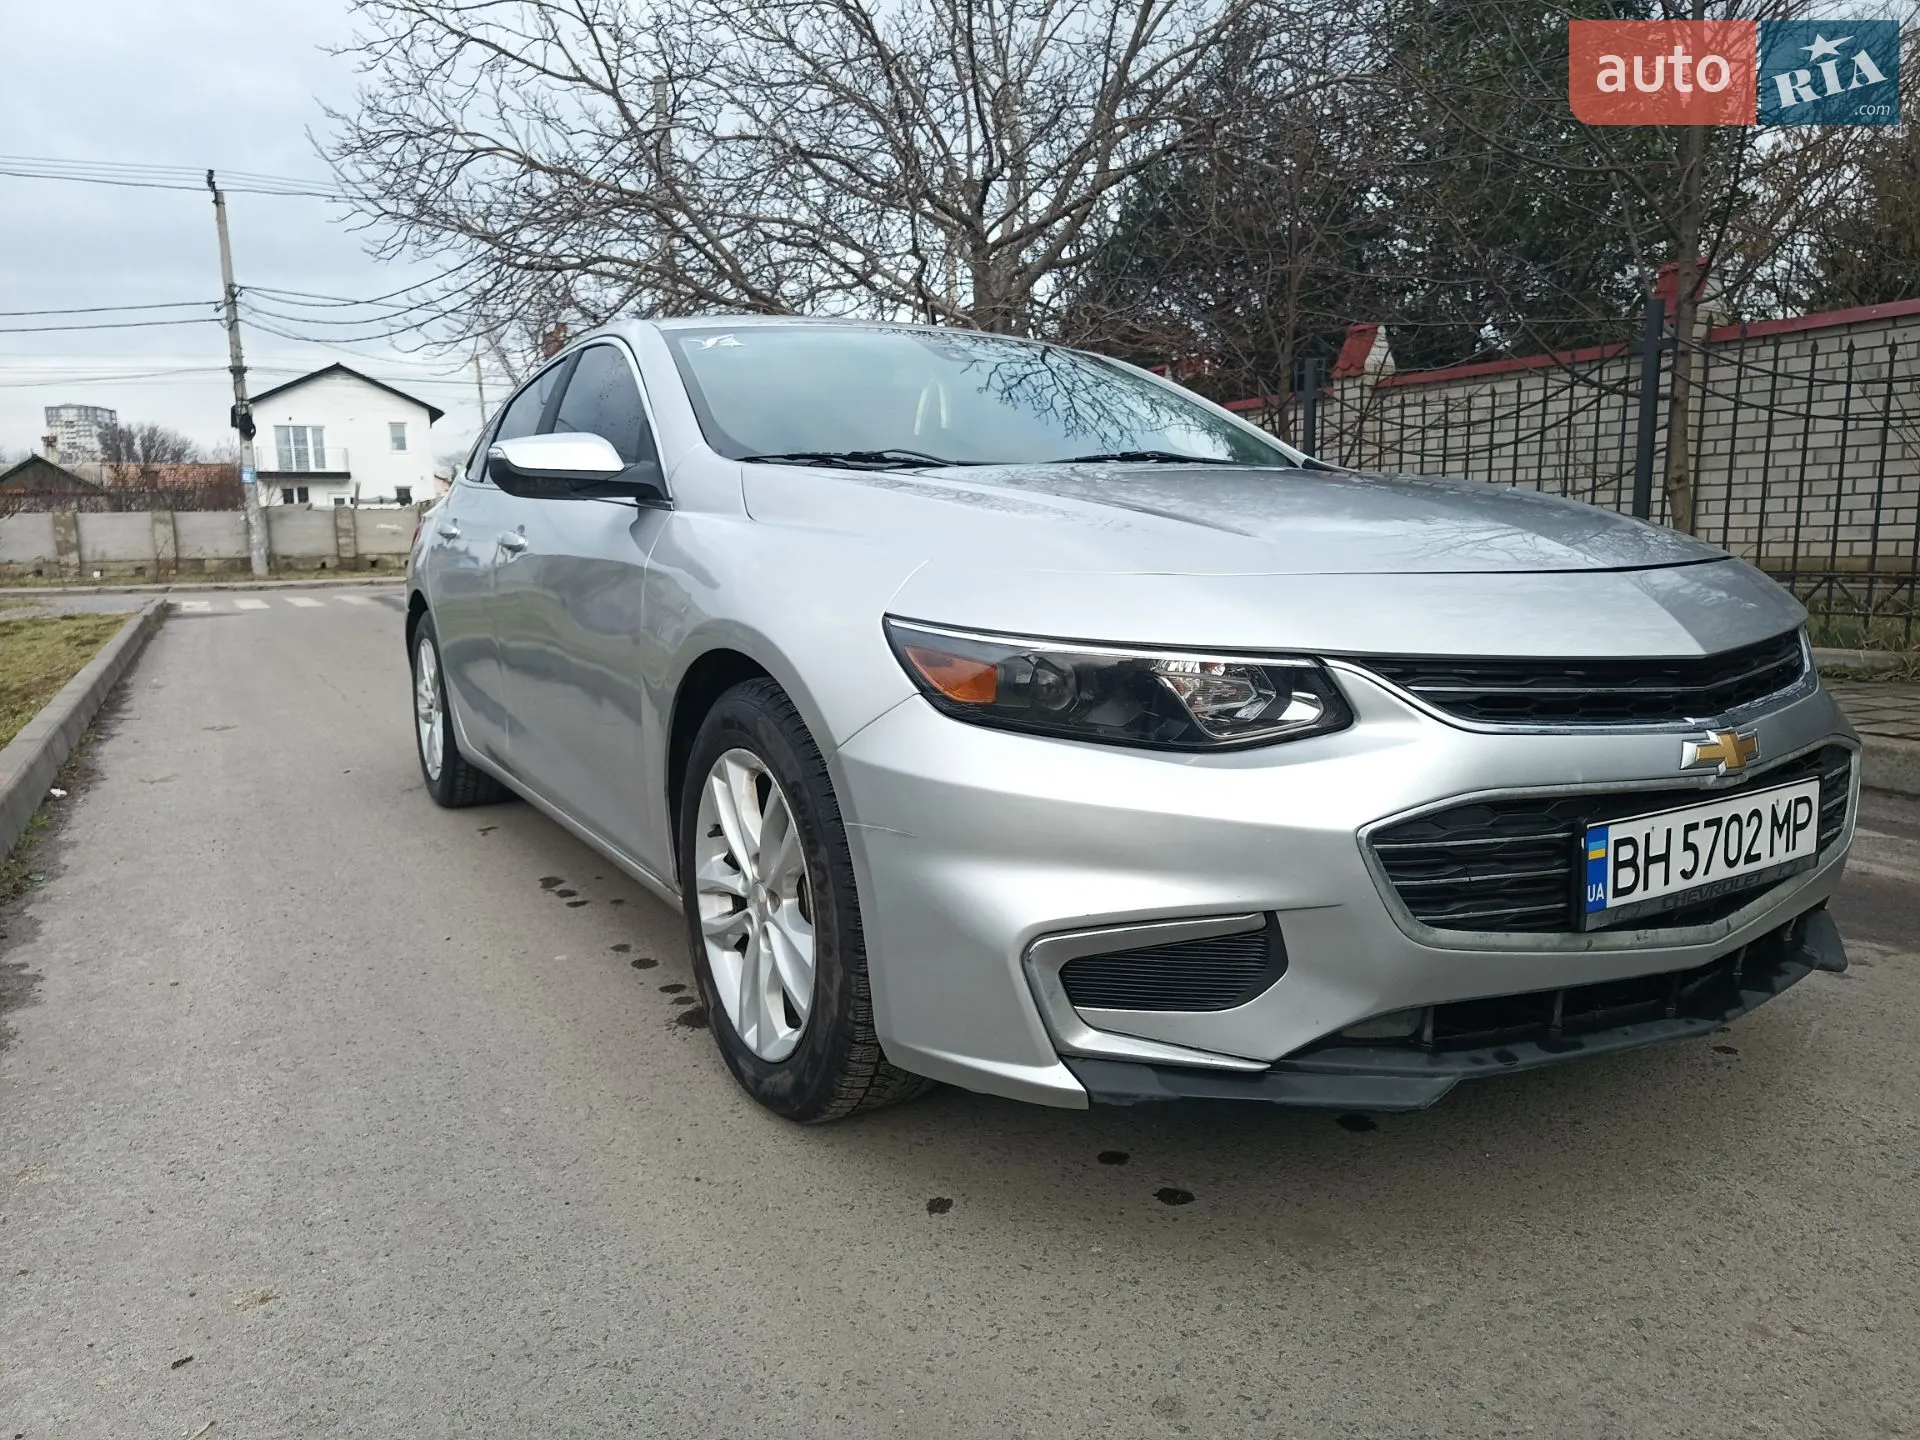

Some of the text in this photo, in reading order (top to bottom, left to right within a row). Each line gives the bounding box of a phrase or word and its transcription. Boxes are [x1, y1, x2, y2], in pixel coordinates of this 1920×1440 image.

[1612, 795, 1813, 899] BH 5702 MP
[1587, 882, 1605, 903] UA
[1661, 872, 1765, 910] CHEVROLET
